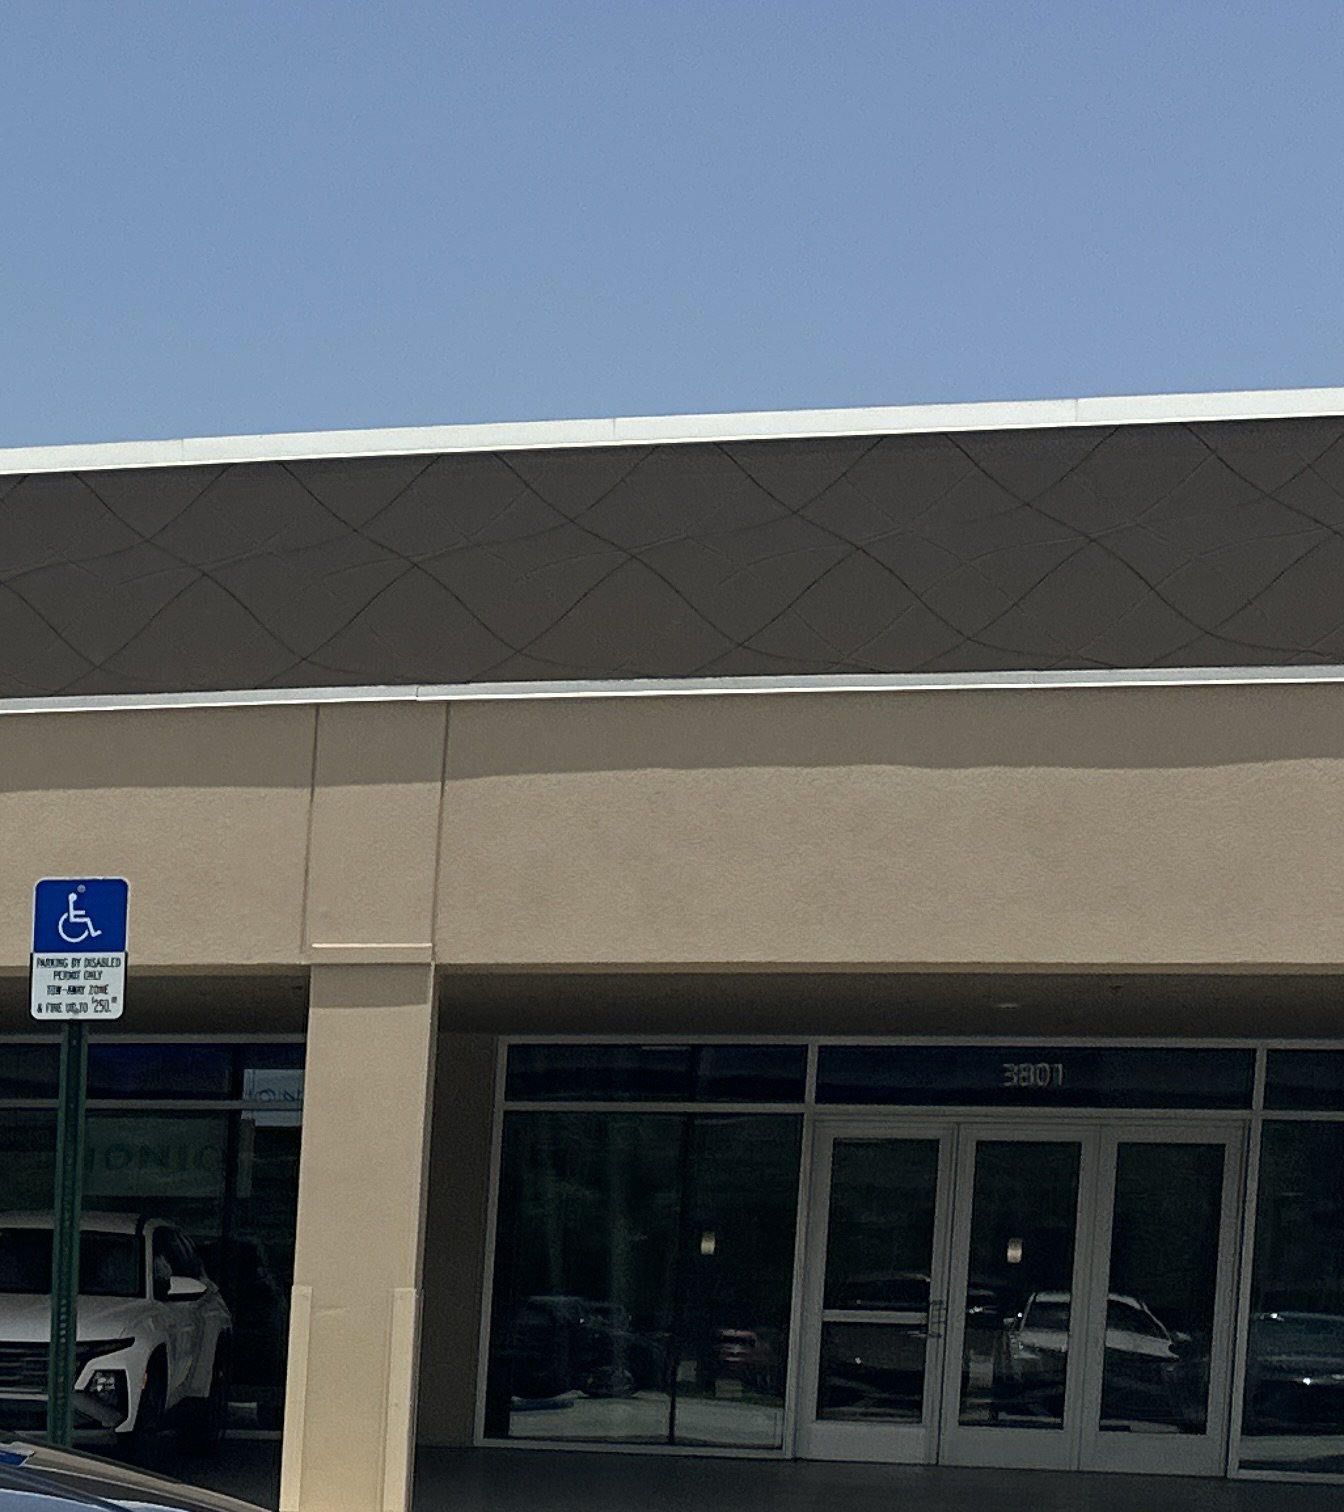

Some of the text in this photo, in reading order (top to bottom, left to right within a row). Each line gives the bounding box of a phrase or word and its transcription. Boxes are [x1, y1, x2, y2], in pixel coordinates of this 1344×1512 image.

[36, 957, 121, 968] PARKING BY DISABLED
[54, 970, 102, 981] PERMIT ONLY
[89, 983, 109, 995] ZONE
[1002, 1062, 1064, 1087] 3801
